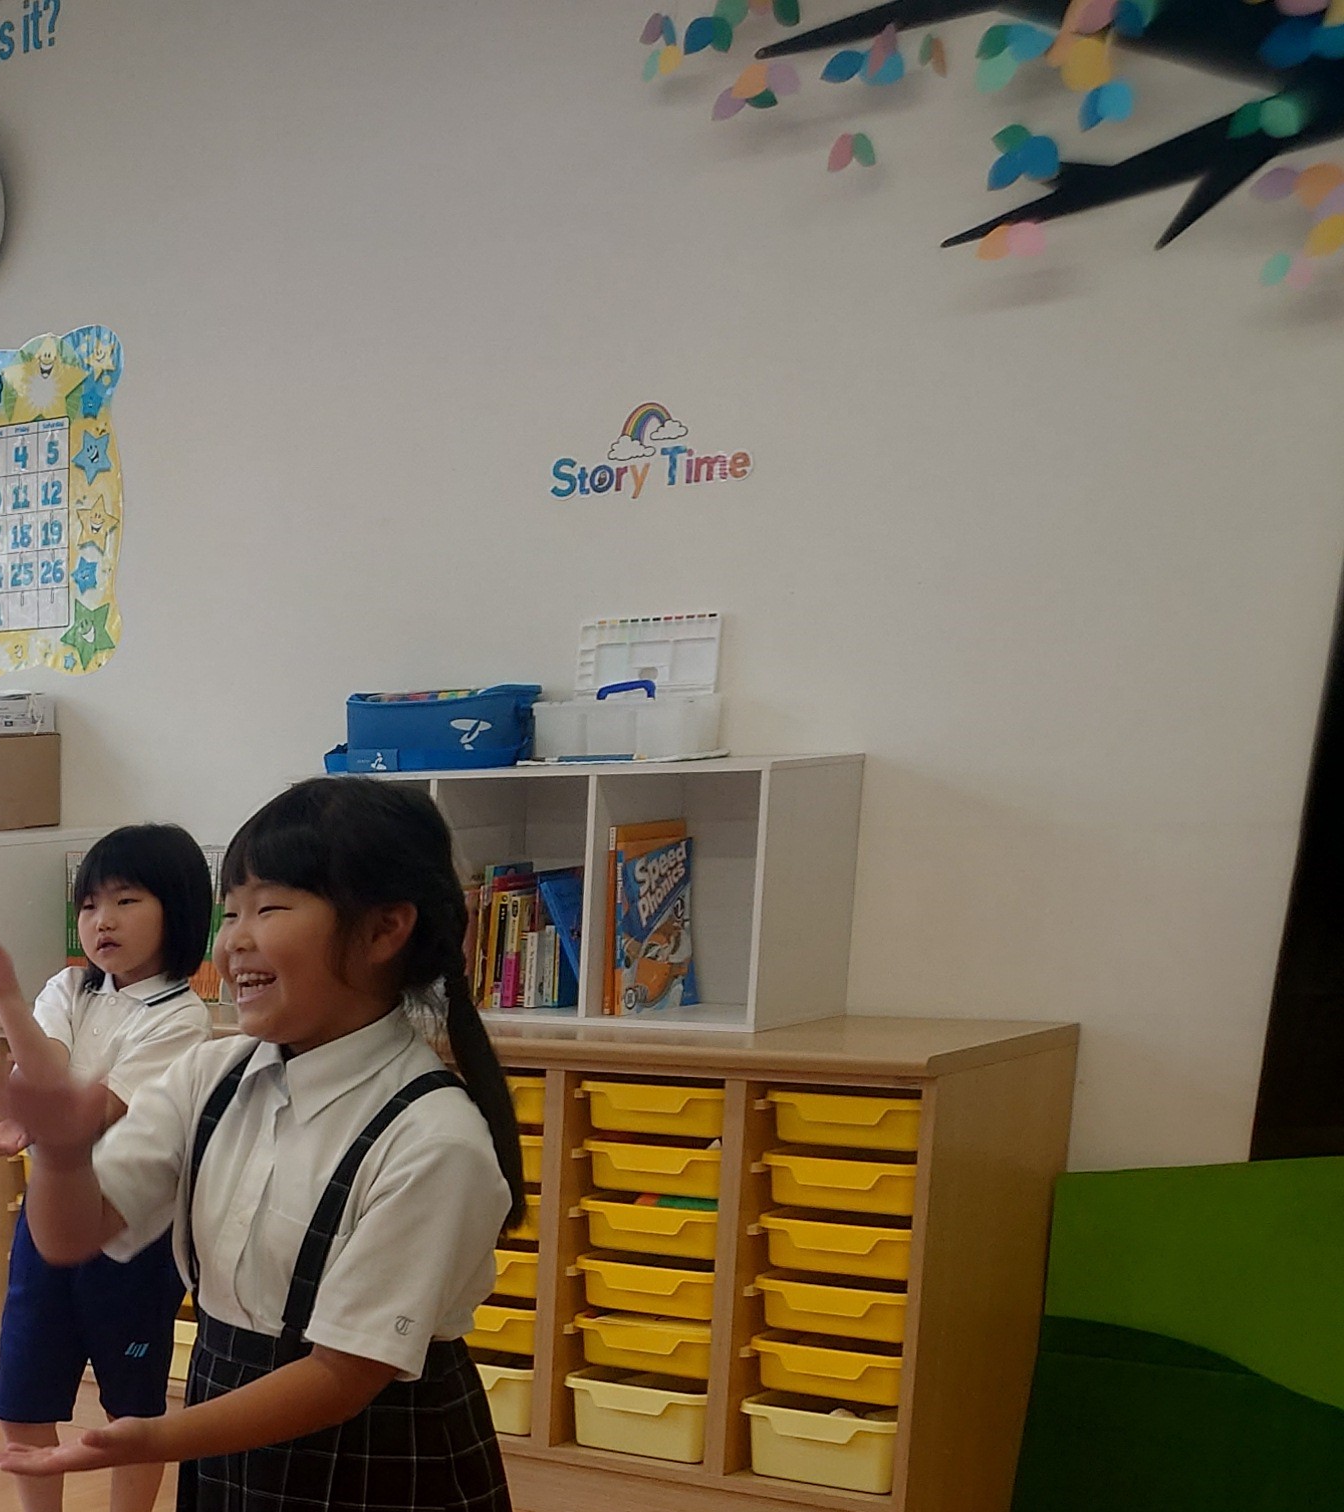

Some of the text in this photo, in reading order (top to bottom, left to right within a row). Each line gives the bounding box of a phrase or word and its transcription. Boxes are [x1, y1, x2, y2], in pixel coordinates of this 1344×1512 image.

[22, 0, 61, 54] it?
[14, 446, 29, 469] 4
[46, 440, 59, 465] 5
[551, 445, 752, 500] Story Time
[13, 485, 30, 510] 11
[41, 480, 62, 506] 12
[12, 523, 32, 549] 18
[41, 519, 62, 546] 19
[11, 562, 34, 587] 25
[40, 559, 64, 584] 26
[634, 840, 687, 896] Speed
